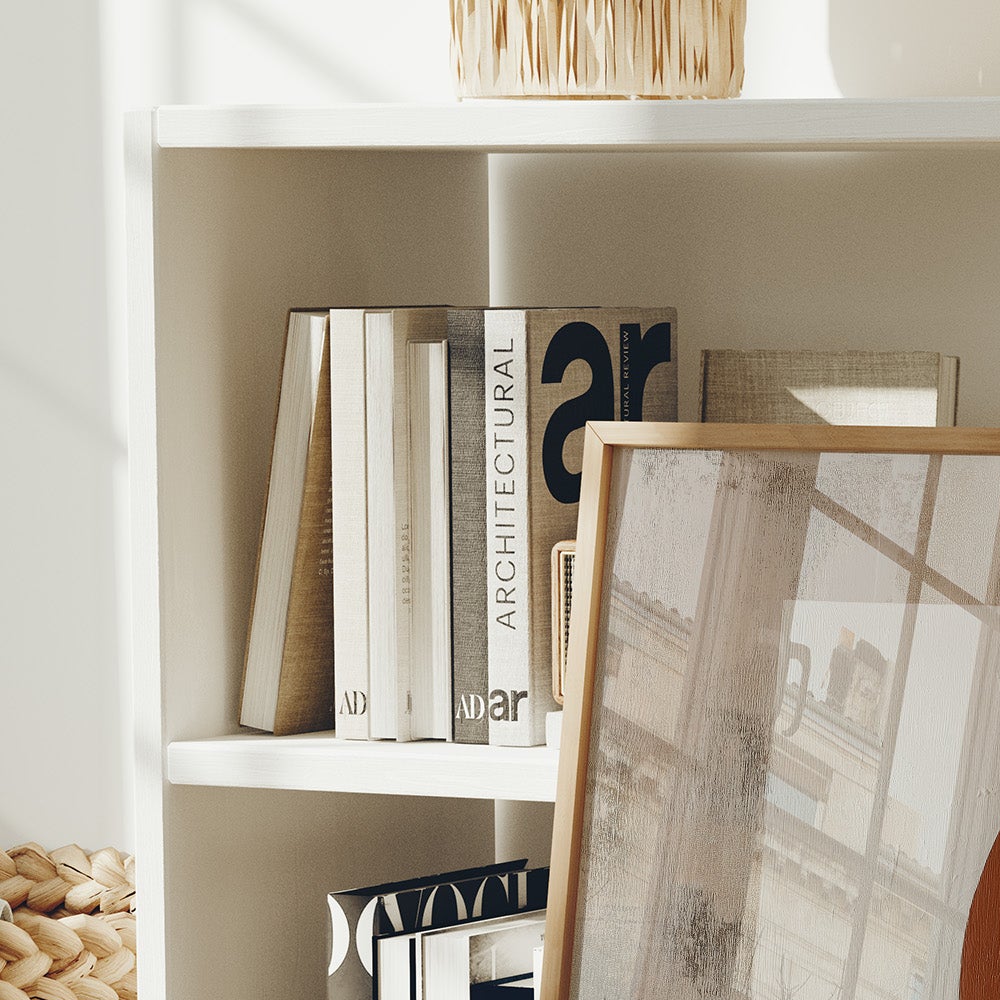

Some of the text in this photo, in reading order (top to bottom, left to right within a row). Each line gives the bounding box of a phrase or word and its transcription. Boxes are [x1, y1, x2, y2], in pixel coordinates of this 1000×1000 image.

[622, 330, 630, 379] REVIEW
[541, 321, 672, 504] ar
[493, 337, 517, 631] ARCHITECTURAL
[339, 690, 368, 715] AD
[455, 693, 486, 721] AD
[489, 689, 528, 722] ar
